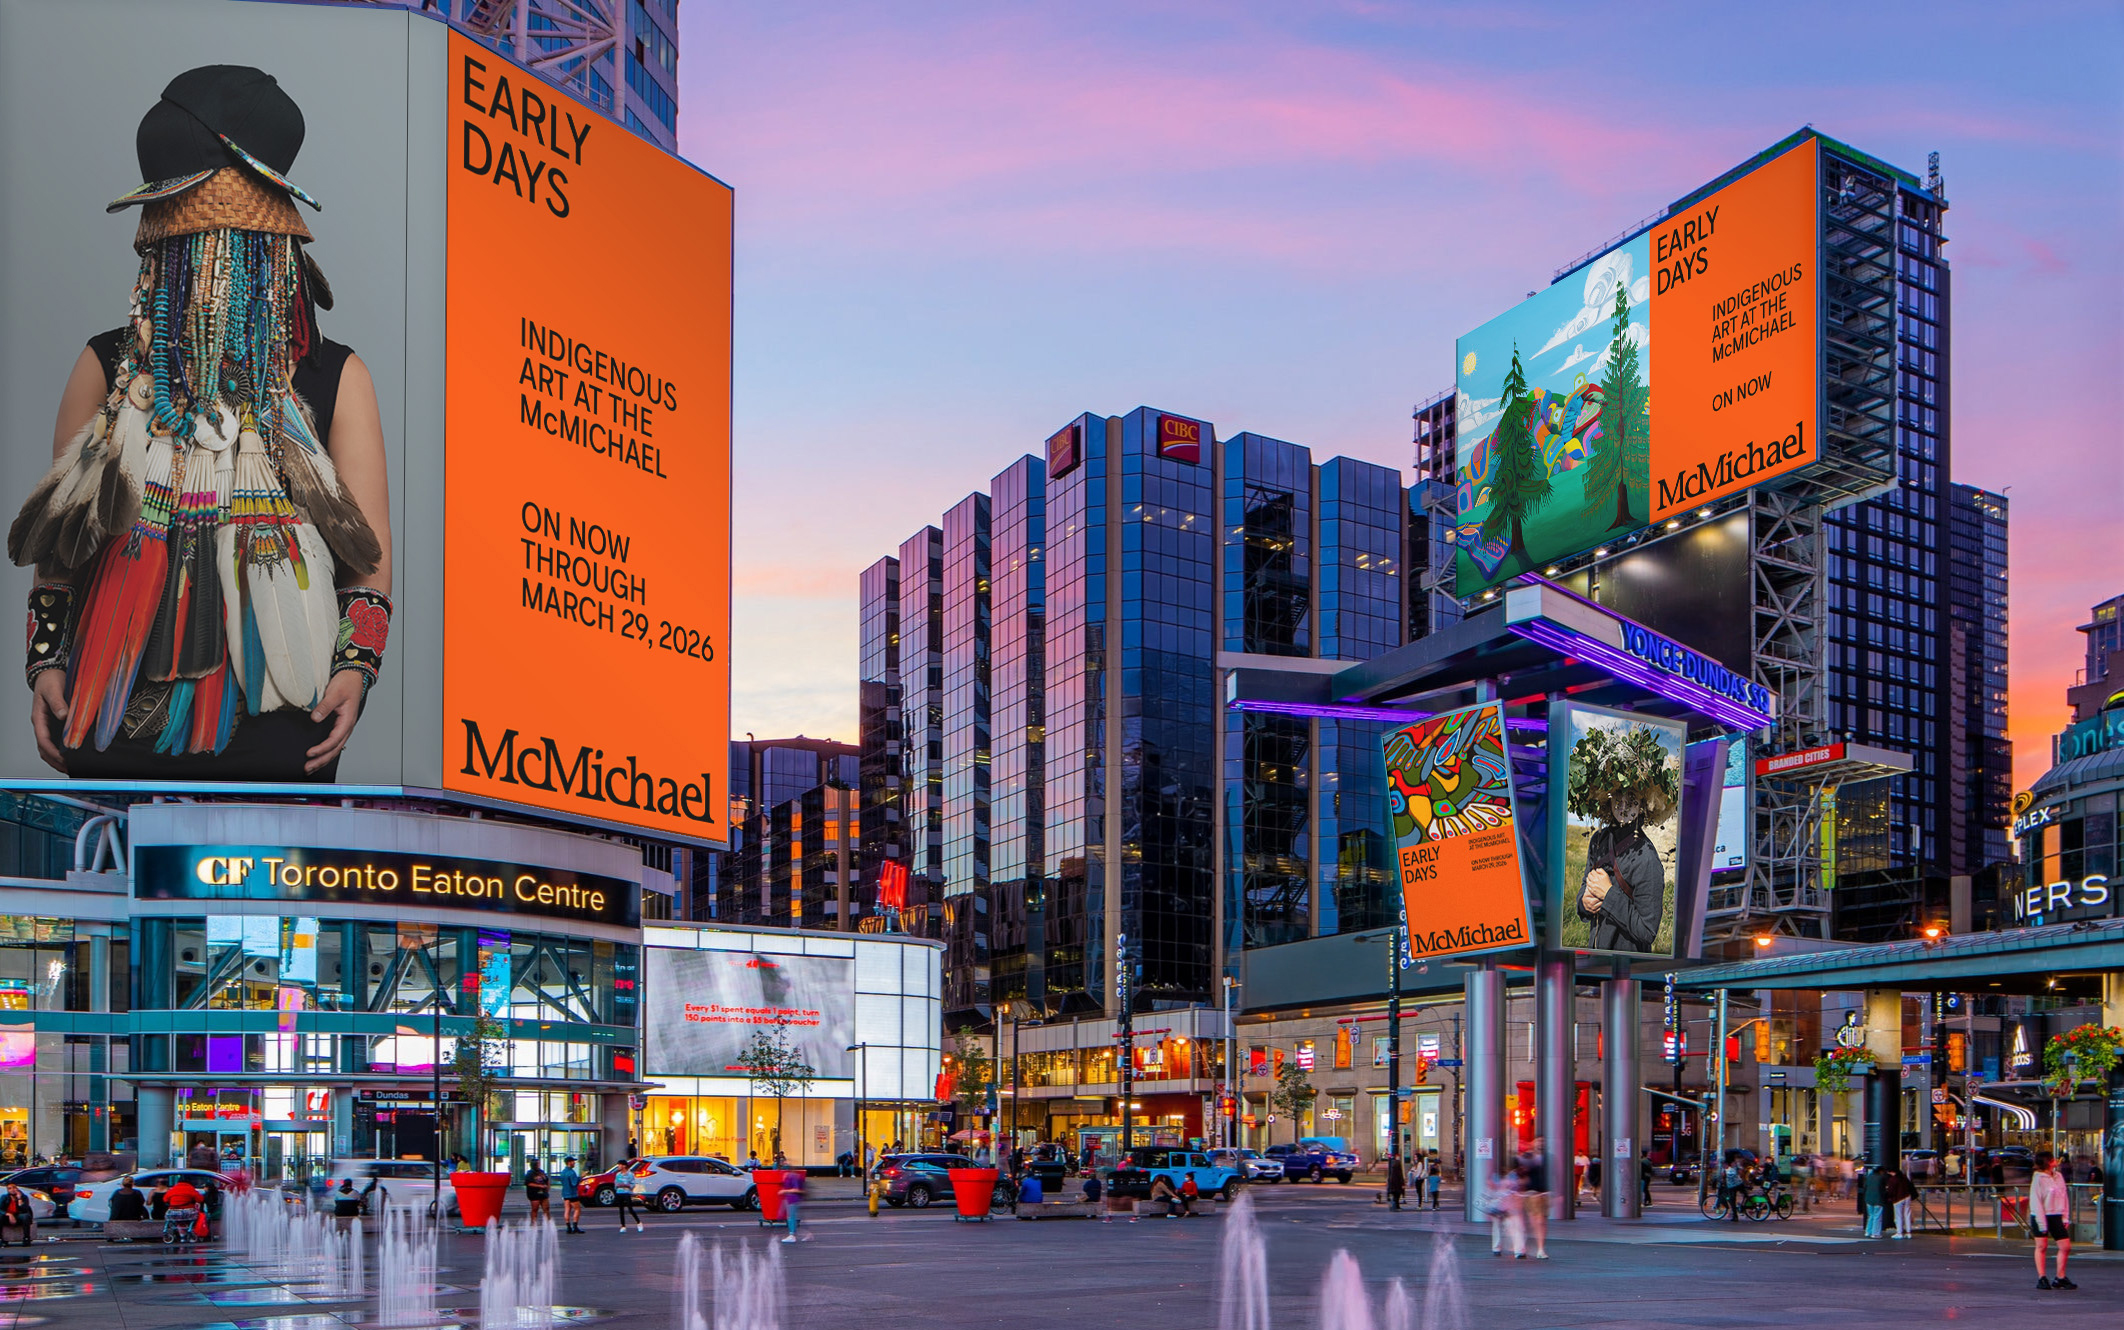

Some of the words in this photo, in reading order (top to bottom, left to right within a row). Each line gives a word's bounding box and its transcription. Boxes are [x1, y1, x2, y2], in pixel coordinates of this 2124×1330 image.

[464, 55, 591, 165] EARLY
[463, 120, 570, 218] DAYS
[1657, 205, 1719, 263] EARLY
[1657, 246, 1708, 296] DAYS
[1712, 263, 1803, 322] INDIGENOUS
[1711, 319, 1738, 343] ART
[1740, 308, 1760, 330] AT
[1759, 292, 1787, 319] THE
[1712, 310, 1797, 363] McMICHAEL
[521, 316, 678, 412] INDIGENOUS
[519, 357, 569, 401] ART
[573, 380, 603, 416] AT
[608, 392, 653, 438] THE
[1711, 388, 1734, 412] ON
[1736, 371, 1772, 404] NOW
[521, 393, 667, 479] McMICHAEL
[1050, 428, 1071, 454] CIBC
[1164, 419, 1198, 441] CIBC
[1657, 420, 1807, 511] McMichael
[521, 501, 561, 541] ON
[570, 516, 631, 563] NOW
[520, 537, 646, 606] THROUGH
[522, 577, 615, 633] MARCH
[620, 609, 654, 649] 29,
[659, 620, 714, 662] 2026
[1750, 682, 1770, 714] SQ
[460, 718, 715, 824] McMichael
[1768, 754, 1804, 771] BRANDED
[1804, 748, 1831, 763] CITIES
[1402, 845, 1440, 867] EARLY
[1405, 865, 1438, 884] DAYS
[197, 857, 254, 886] CF
[261, 857, 399, 892] Toronto
[411, 864, 504, 899] Eaton
[514, 874, 605, 912] Centre
[1414, 918, 1524, 954] McMichael
[685, 1003, 709, 1014] Every
[711, 1004, 719, 1013] $1
[721, 1006, 744, 1014] spent
[685, 1013, 699, 1021] 150
[701, 1015, 726, 1023] points
[753, 1016, 762, 1024] $5
[191, 1102, 213, 1112] Eaton
[376, 1091, 410, 1099] Dundas
